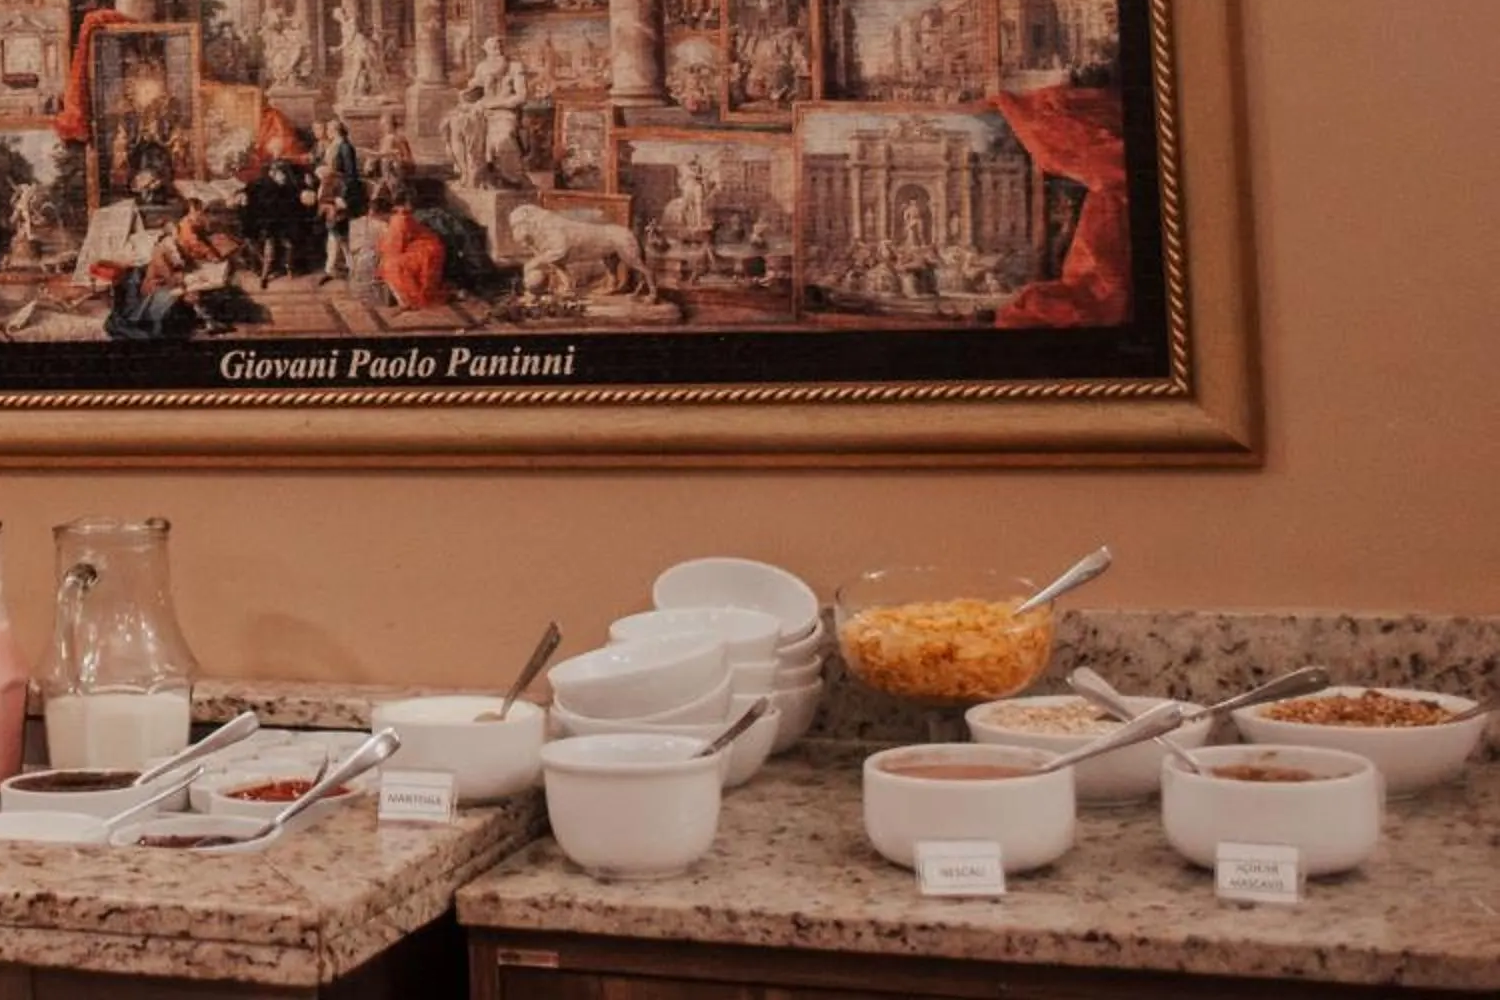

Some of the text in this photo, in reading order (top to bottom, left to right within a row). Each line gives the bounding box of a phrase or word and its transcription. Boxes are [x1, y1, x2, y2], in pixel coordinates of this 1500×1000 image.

[219, 345, 576, 380] Giovani Paolo Paninni
